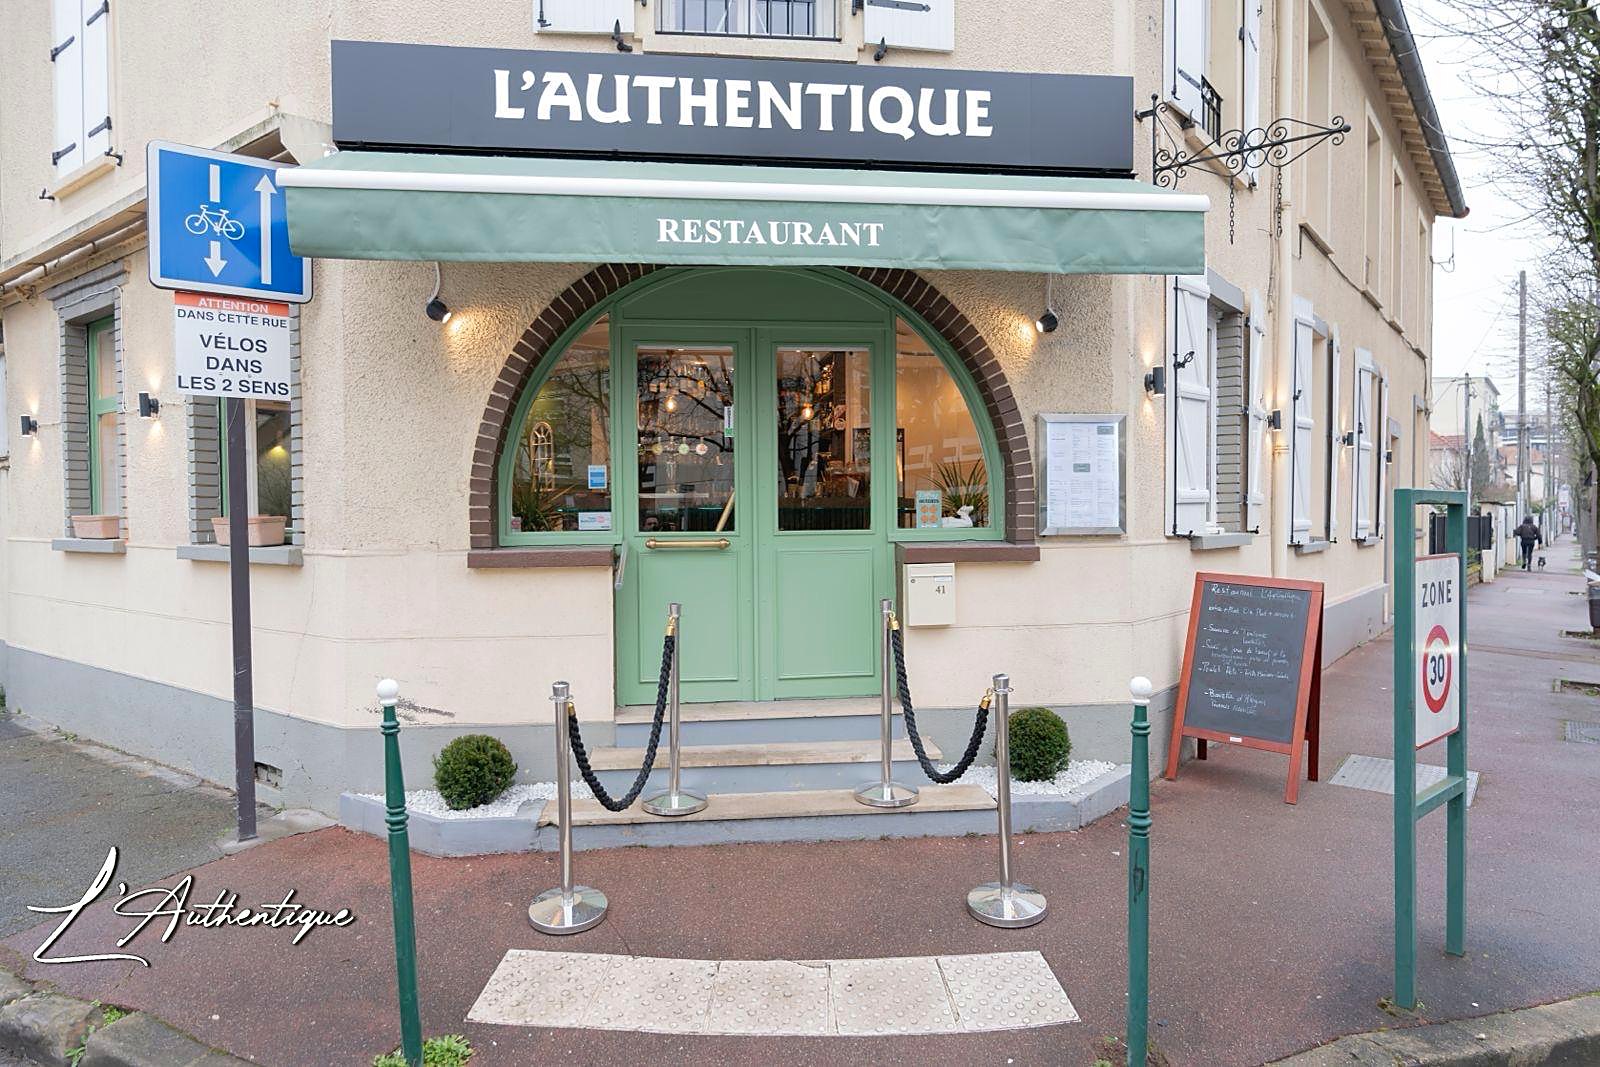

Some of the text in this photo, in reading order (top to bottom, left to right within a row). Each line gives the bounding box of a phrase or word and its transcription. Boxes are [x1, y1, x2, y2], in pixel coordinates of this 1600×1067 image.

[493, 69, 994, 141] L'AUTHENTIQUE
[657, 218, 884, 248] RESTAURANT
[198, 298, 269, 314] ATTENTION
[177, 309, 288, 328] DANS CETTE RUE
[200, 333, 267, 353] VÉLOS
[206, 356, 263, 374] DANS
[178, 375, 289, 396] LES 2 SENS
[935, 585, 946, 594] 41
[1422, 580, 1452, 608] ZONE
[1430, 653, 1445, 686] 30
